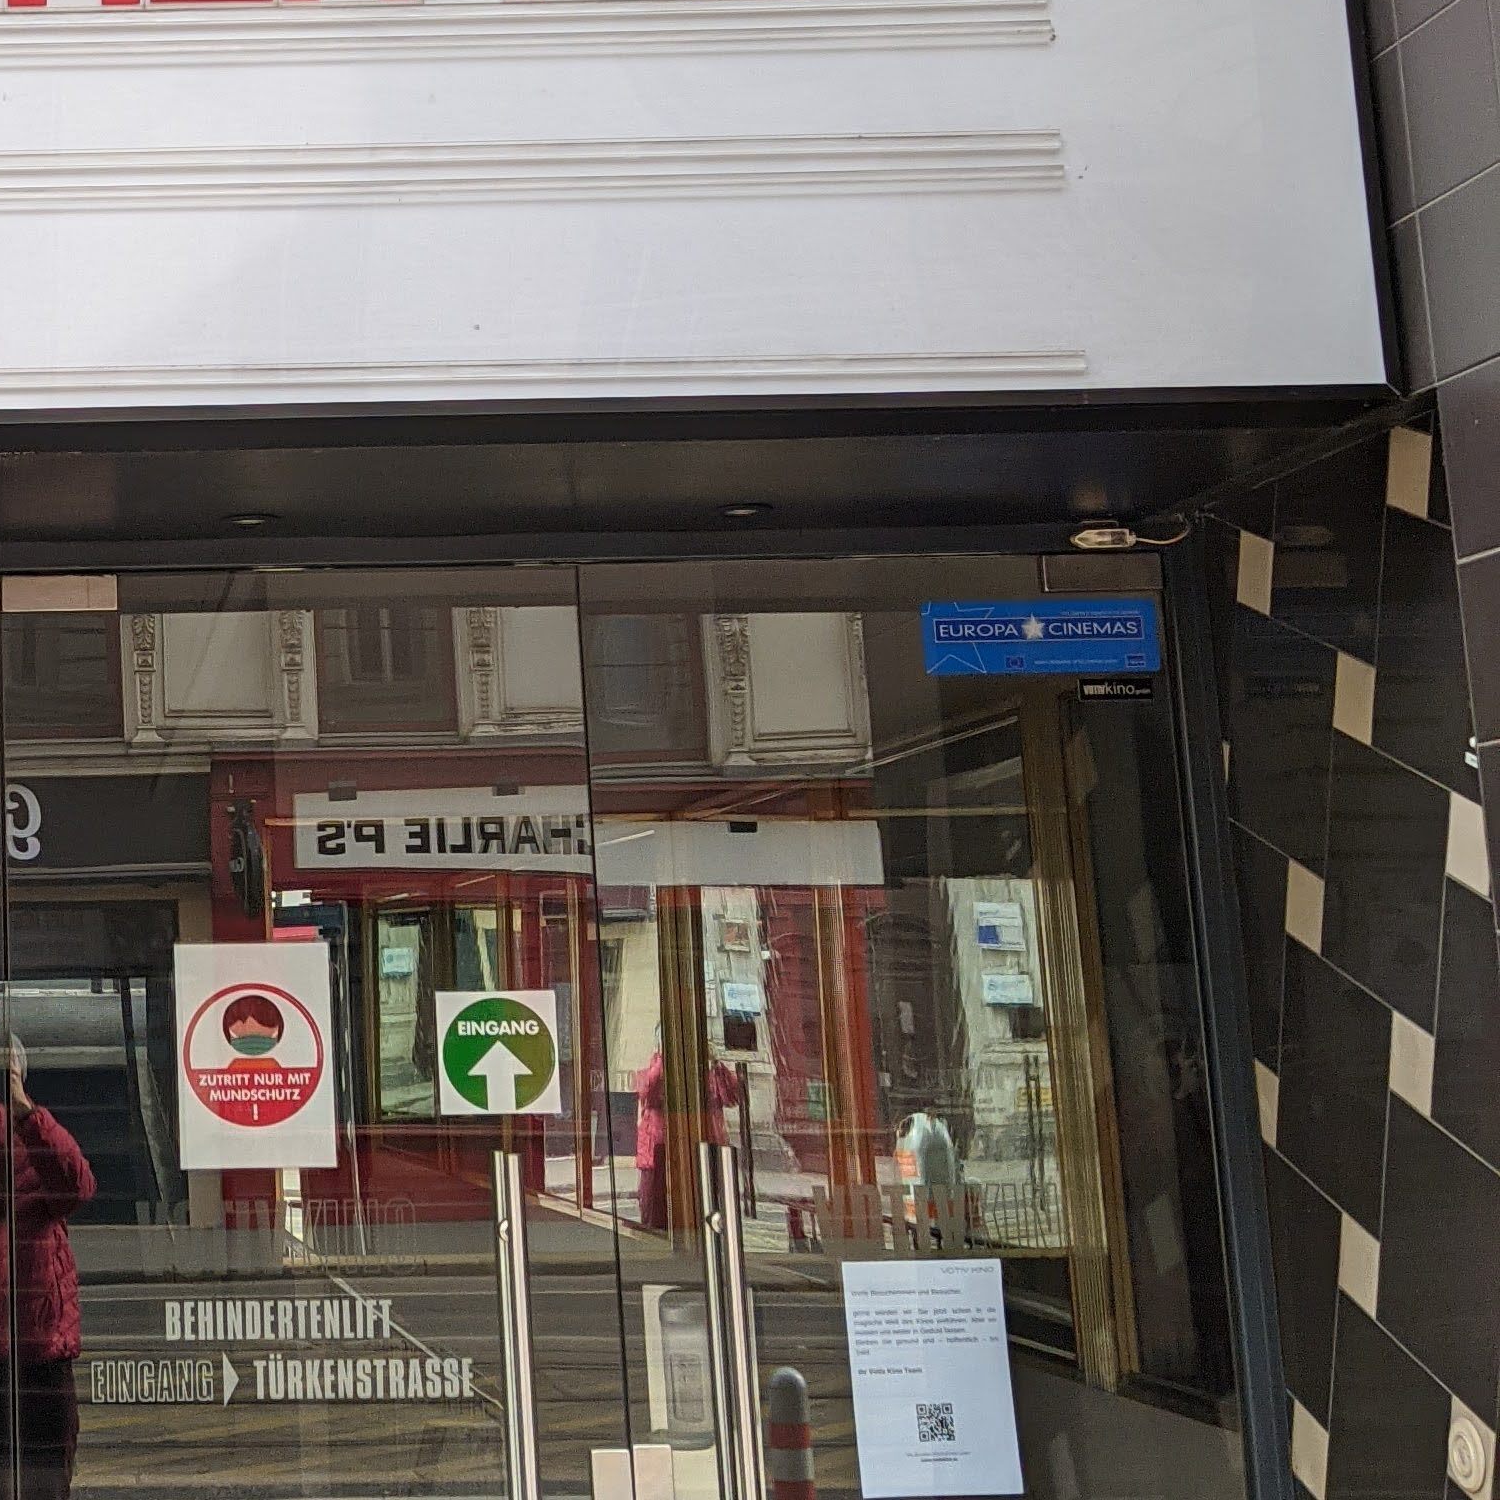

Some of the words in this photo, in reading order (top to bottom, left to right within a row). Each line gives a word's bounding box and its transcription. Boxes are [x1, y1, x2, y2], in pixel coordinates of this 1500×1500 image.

[939, 623, 1018, 638] EUROPA
[1048, 621, 1138, 636] CINEMAS
[457, 1019, 540, 1037] EINGANG
[198, 1073, 250, 1086] ZUTRITT
[253, 1073, 284, 1086] NUR
[287, 1072, 311, 1085] MIT
[209, 1088, 301, 1102] MUNDSCHUTZ
[165, 1300, 392, 1341] BEHINDERTENLIFT
[91, 1360, 214, 1403] EINGANG
[253, 1354, 475, 1400] TÜRKENSTRASSE
